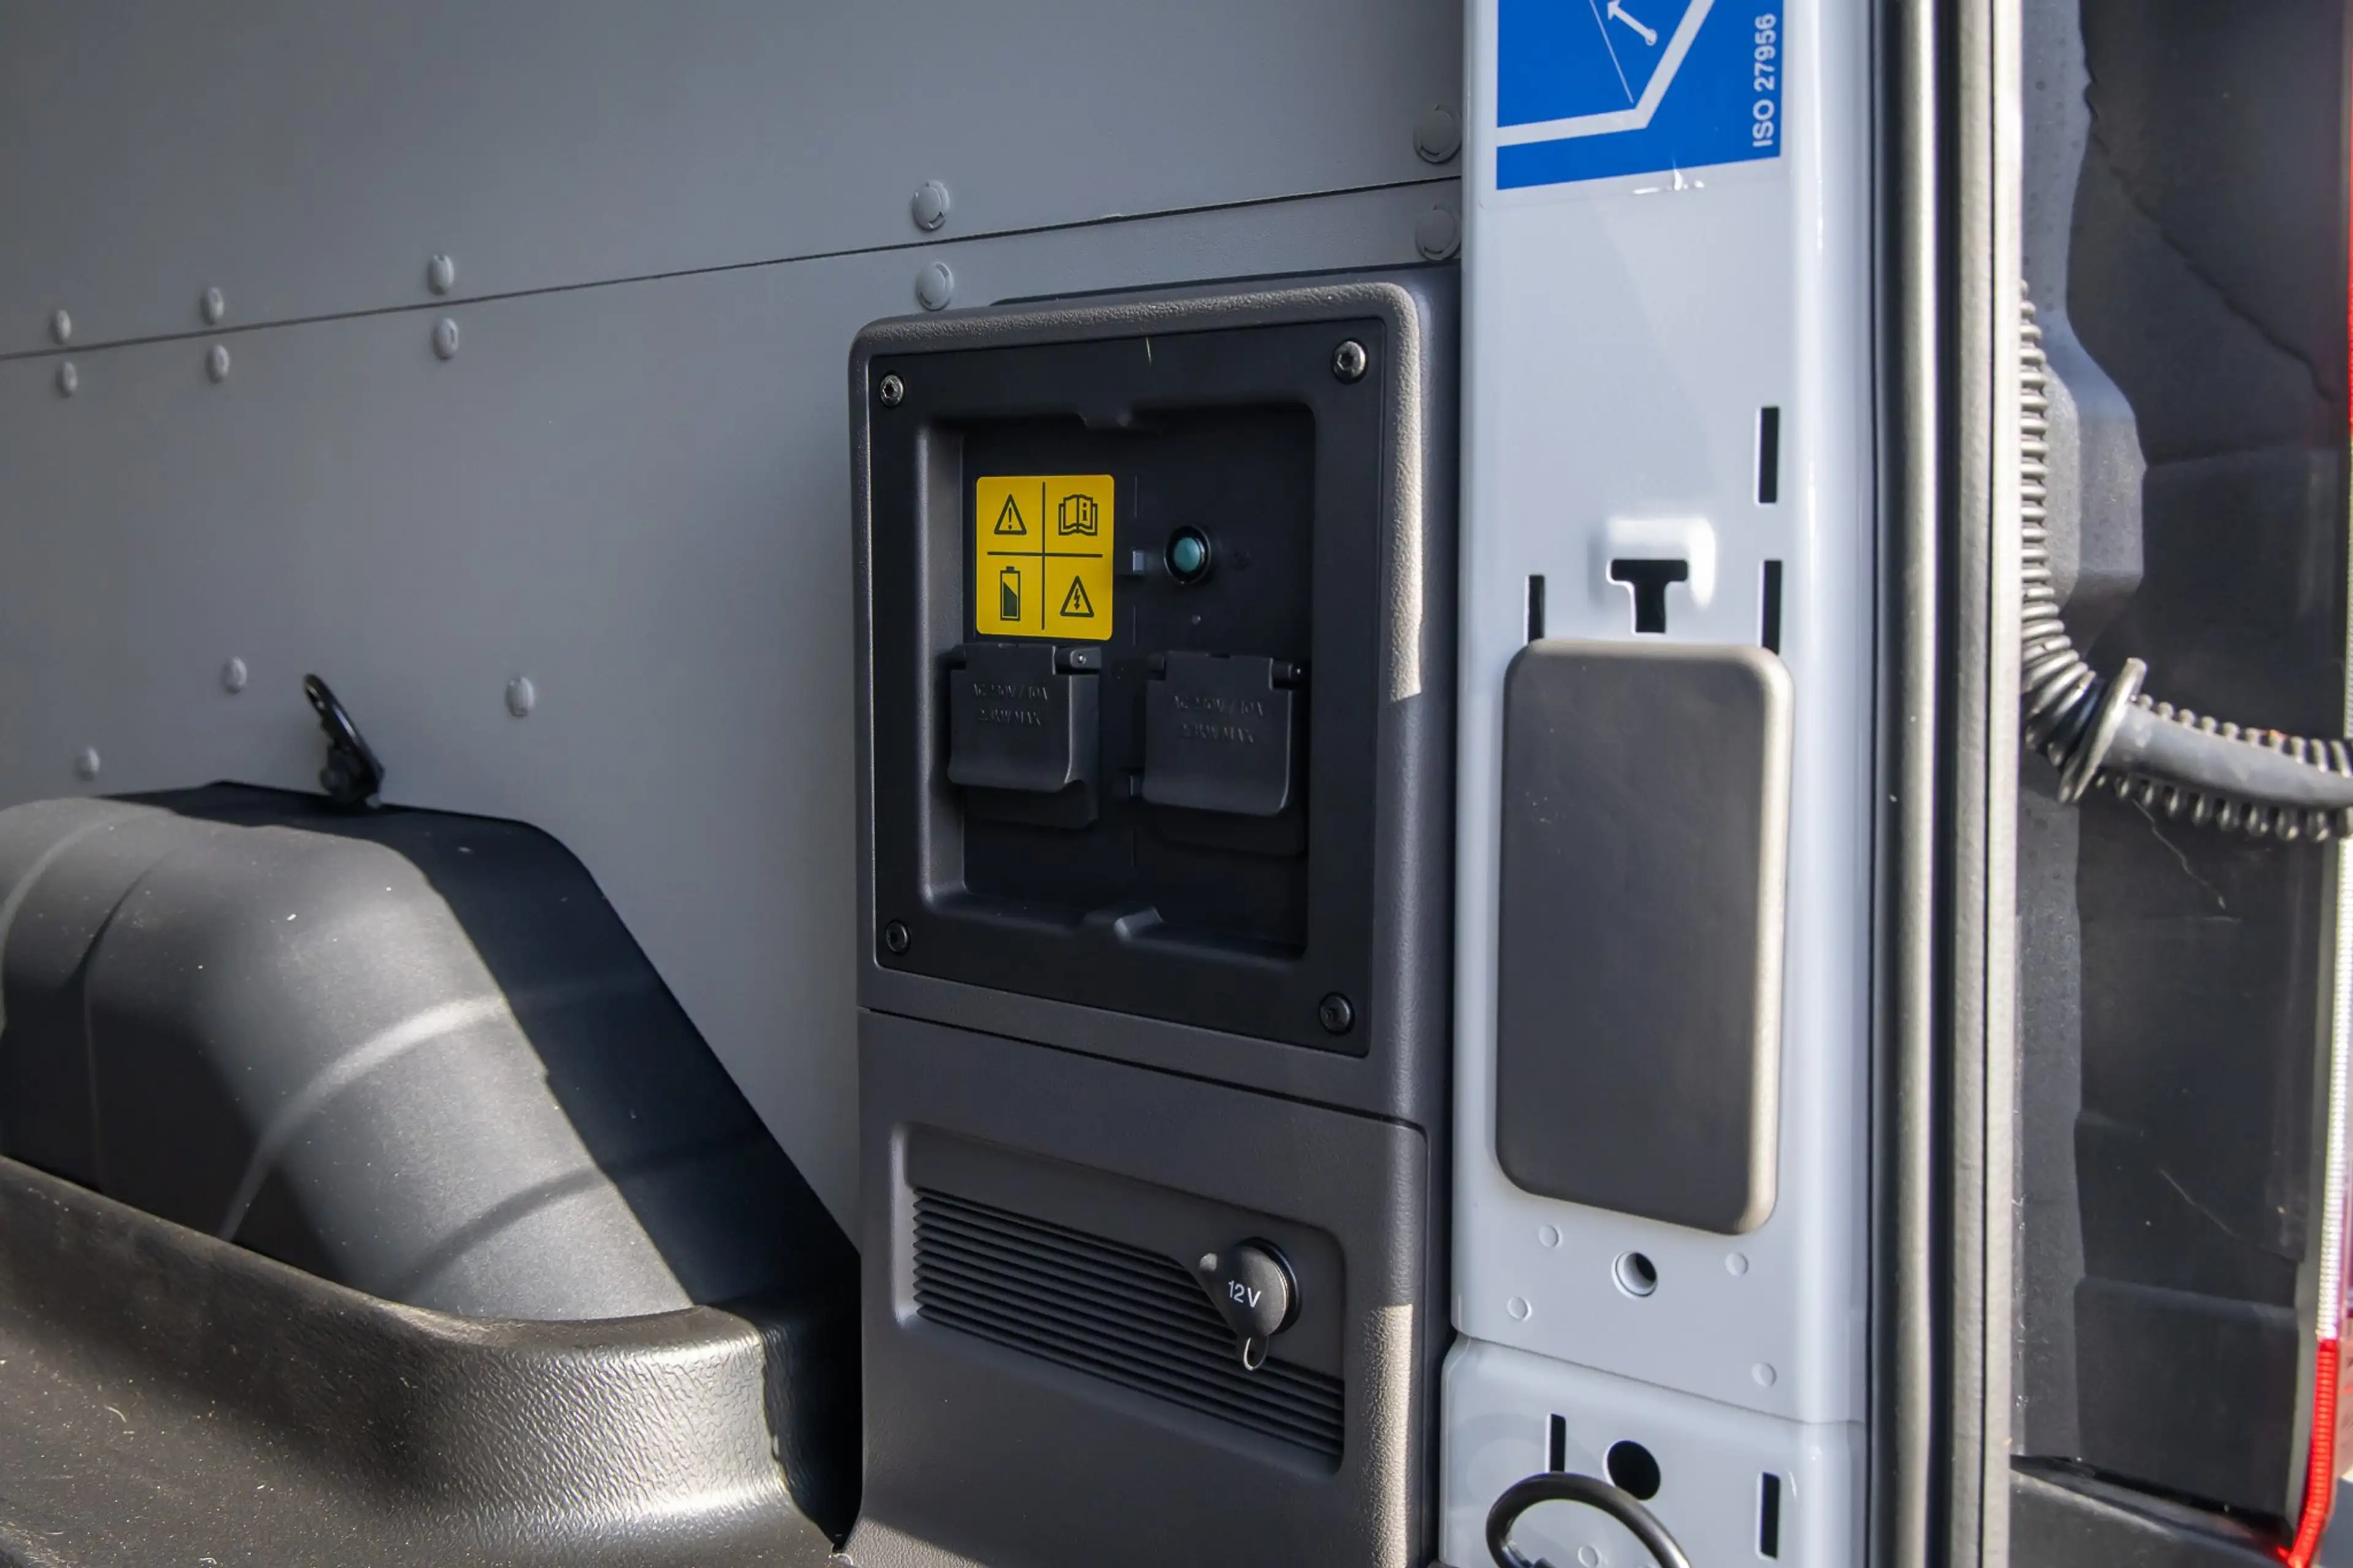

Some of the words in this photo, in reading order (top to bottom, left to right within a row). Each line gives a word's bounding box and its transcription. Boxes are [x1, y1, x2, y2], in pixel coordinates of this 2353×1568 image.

[1753, 13, 1777, 93] 27956
[1752, 98, 1775, 148] ISO
[1228, 1280, 1262, 1309] 12V
